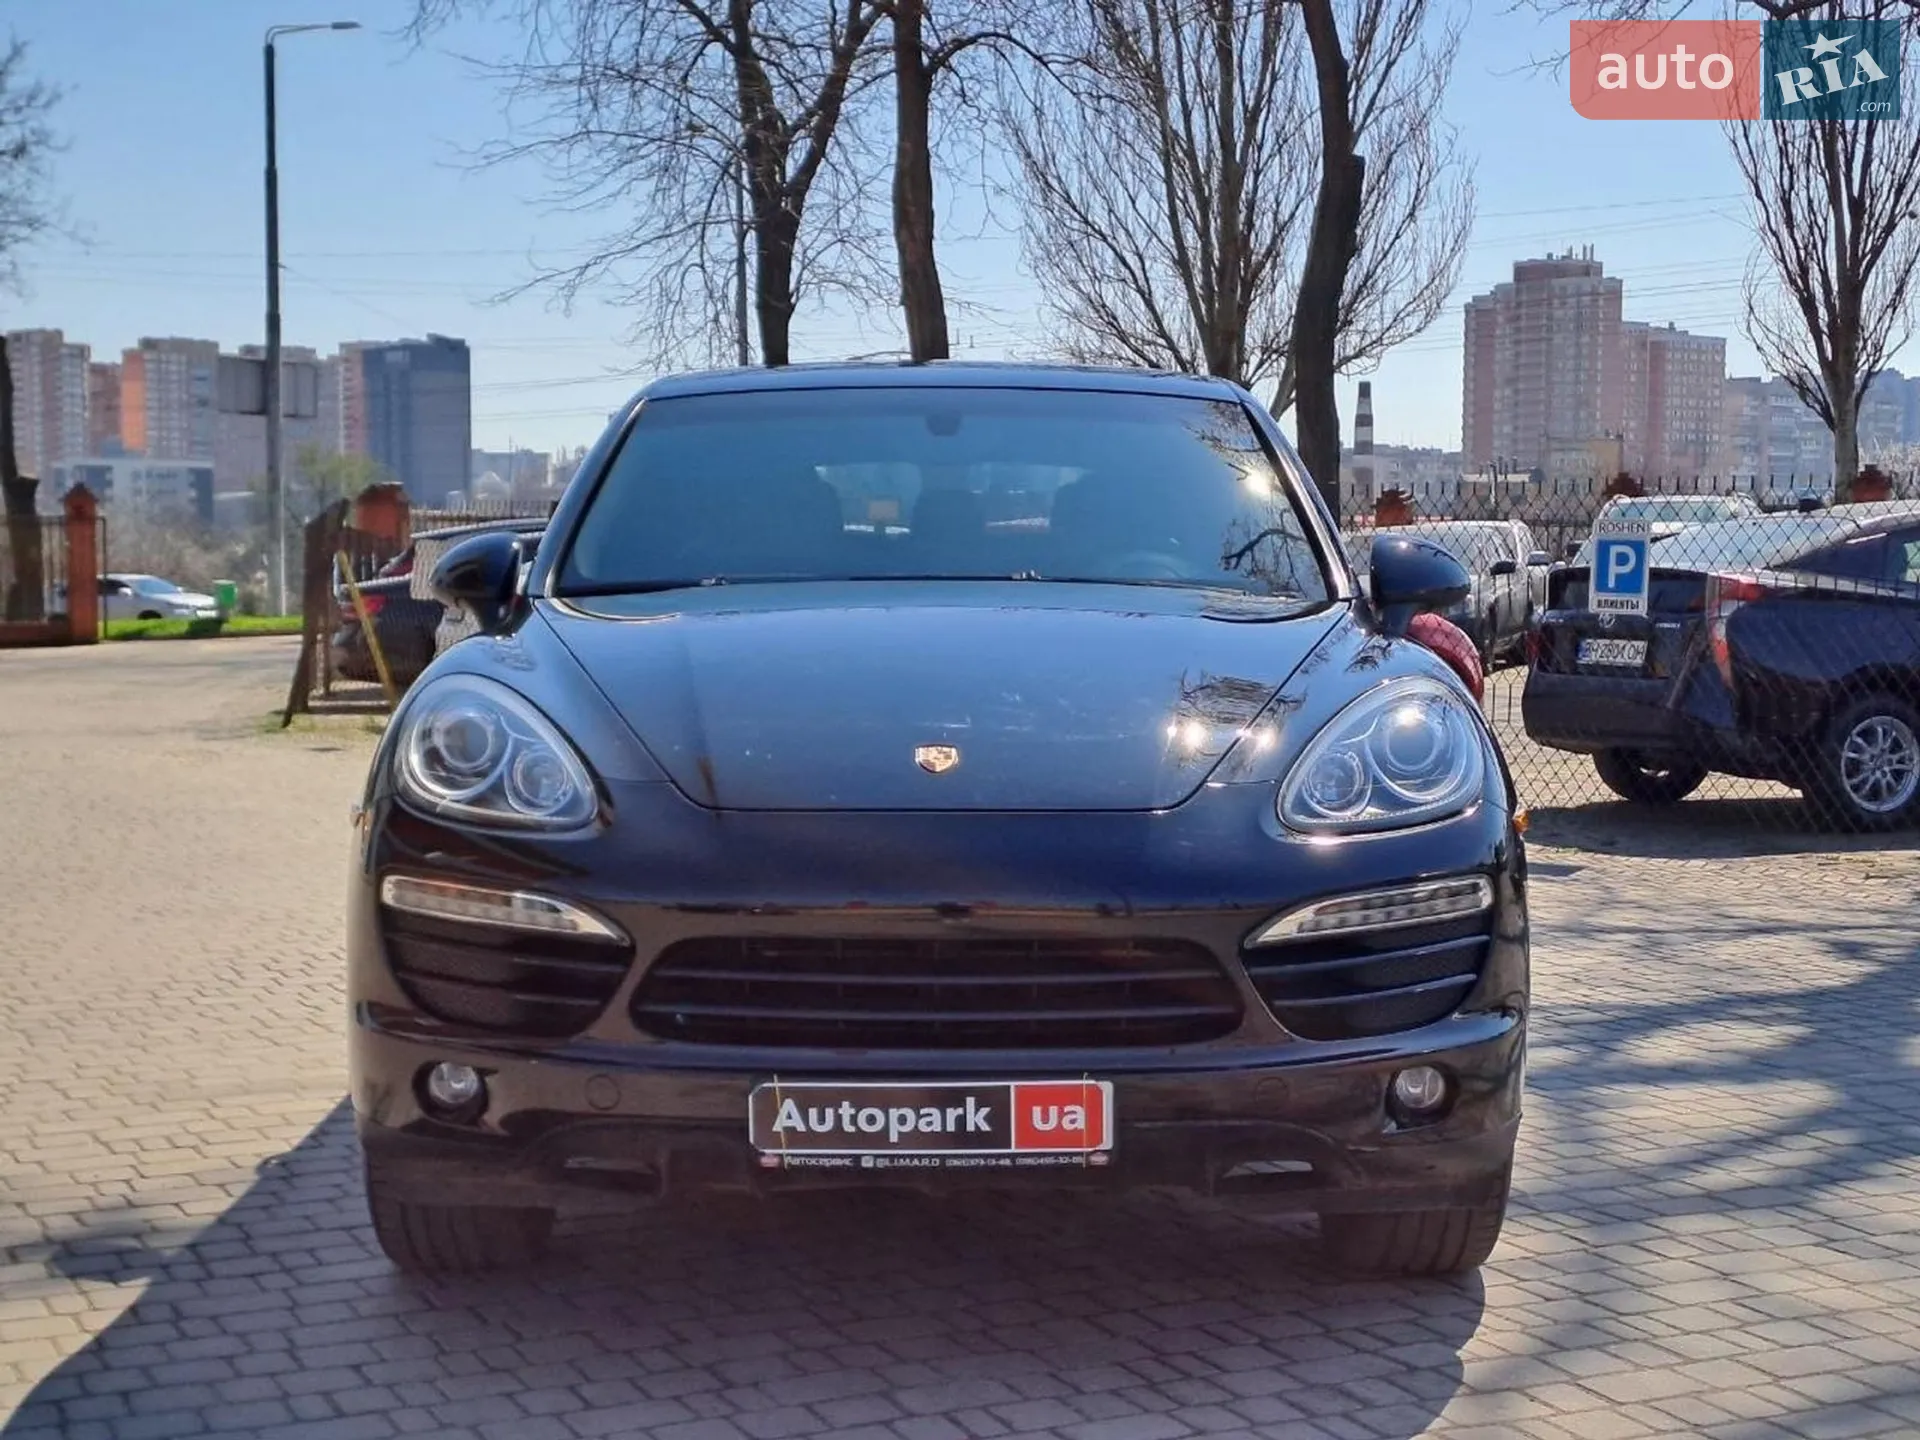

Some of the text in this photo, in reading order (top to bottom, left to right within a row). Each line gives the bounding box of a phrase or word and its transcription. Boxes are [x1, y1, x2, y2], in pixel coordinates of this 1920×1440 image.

[1598, 521, 1646, 534] ROSHEN
[1607, 544, 1637, 589] P
[771, 1096, 1087, 1143] Autopark ua
